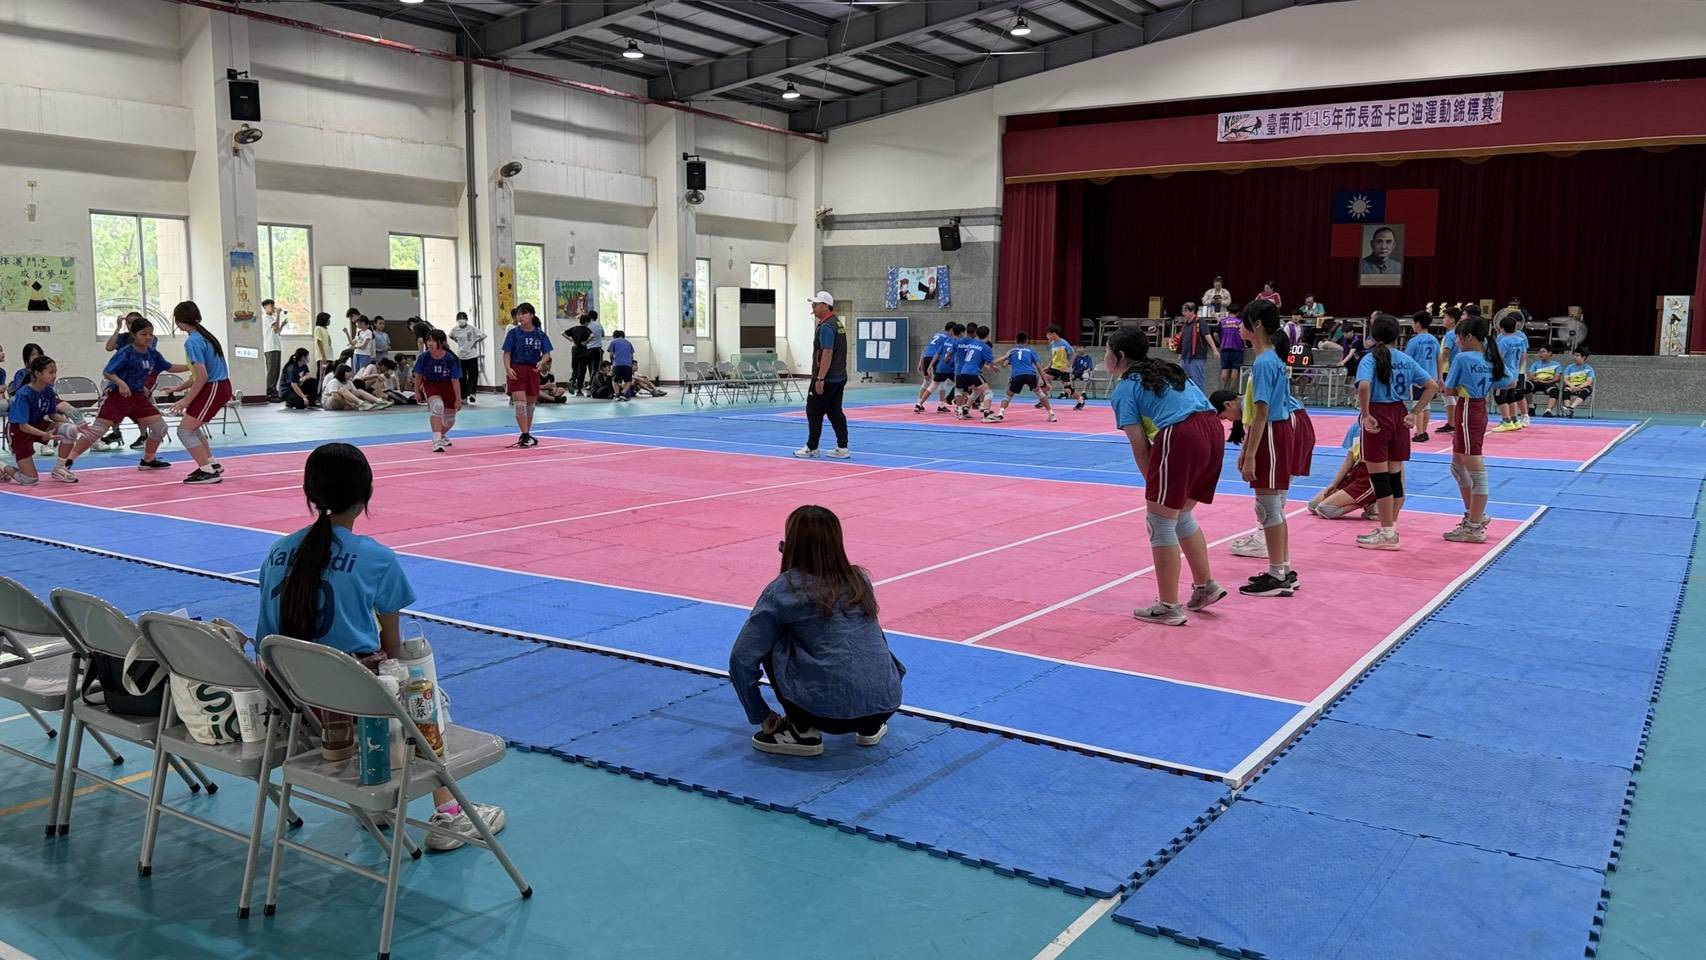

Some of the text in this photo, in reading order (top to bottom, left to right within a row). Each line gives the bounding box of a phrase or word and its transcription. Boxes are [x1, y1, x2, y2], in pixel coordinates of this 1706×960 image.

[1266, 97, 1495, 136] 臺南市115年市長盃卡巴迪運動錦標賽
[525, 337, 534, 346] 12
[1424, 346, 1433, 360] 2
[1302, 355, 1309, 366] 0
